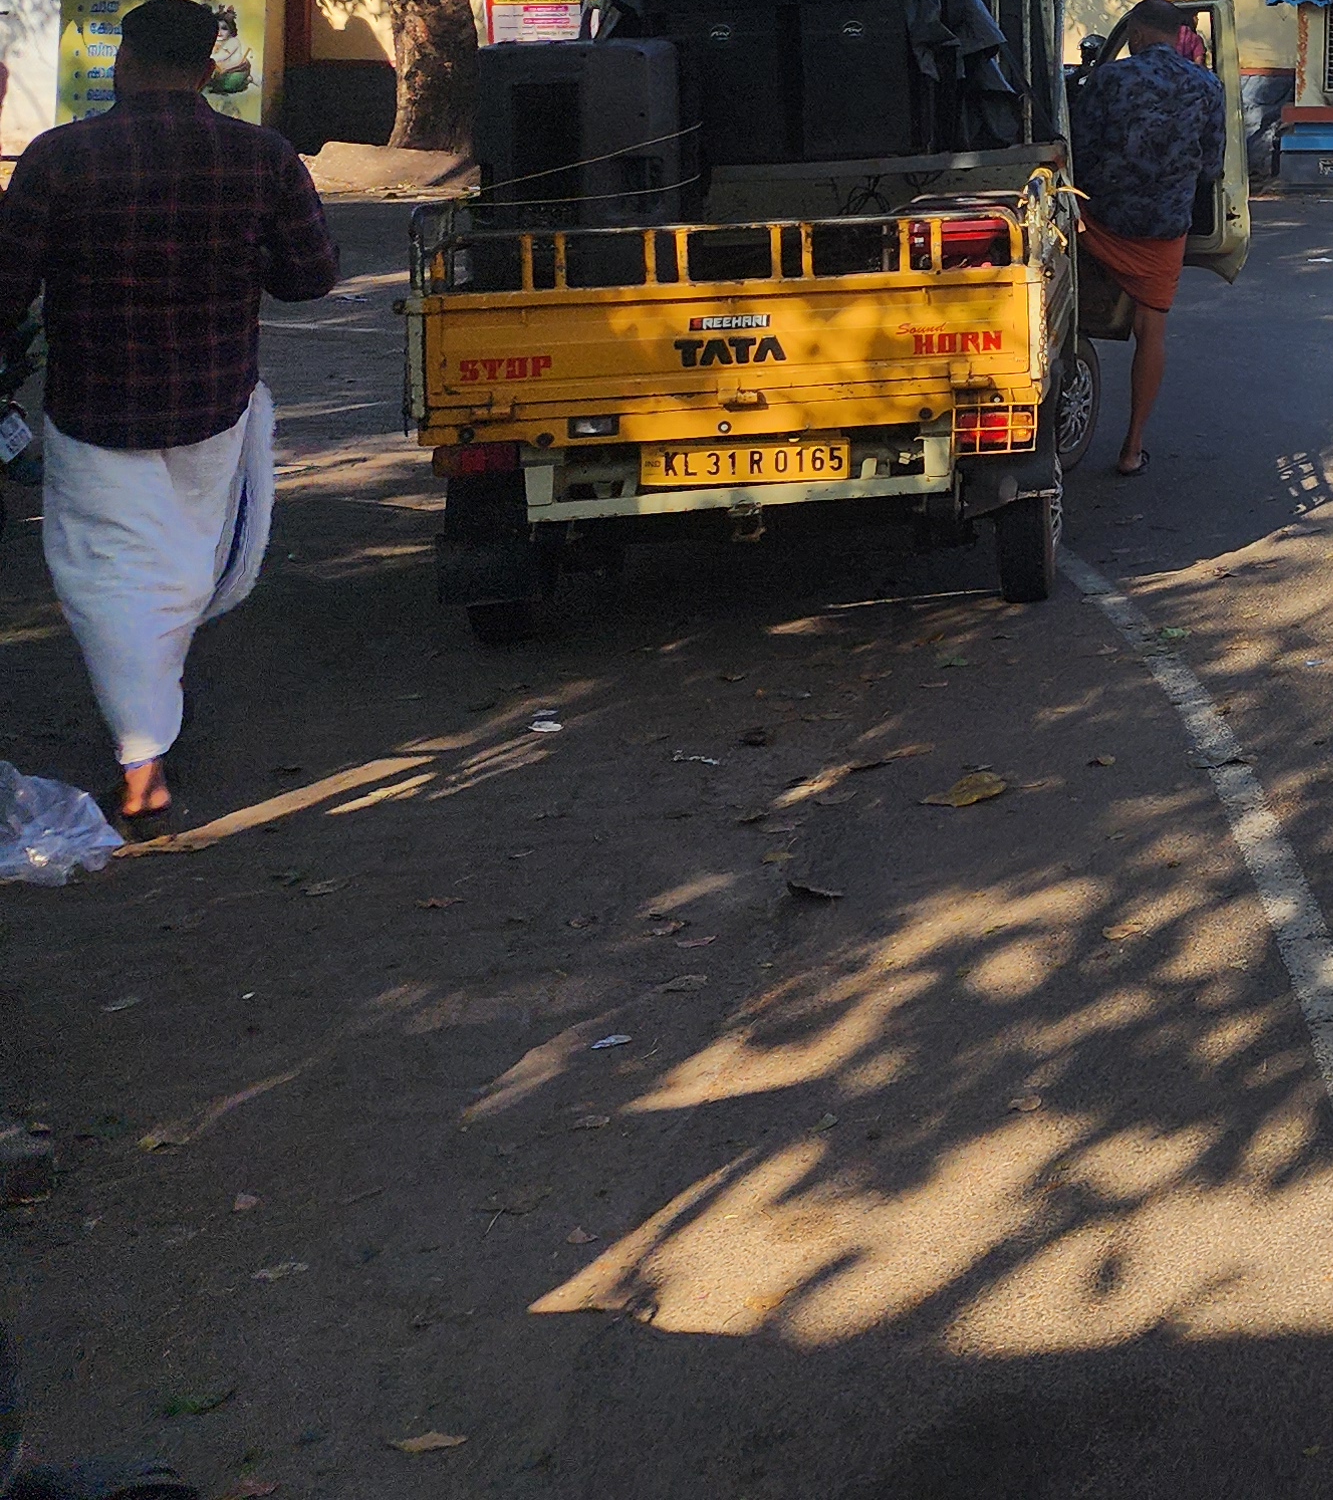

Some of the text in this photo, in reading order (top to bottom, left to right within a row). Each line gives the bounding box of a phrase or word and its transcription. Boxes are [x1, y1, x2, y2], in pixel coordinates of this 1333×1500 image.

[690, 314, 769, 331] SREEHARI
[896, 321, 947, 335] Sound
[674, 336, 787, 367] TATA
[913, 330, 1003, 355] HORN
[459, 355, 553, 382] STOP
[664, 446, 844, 477] KL 31 R 0165
